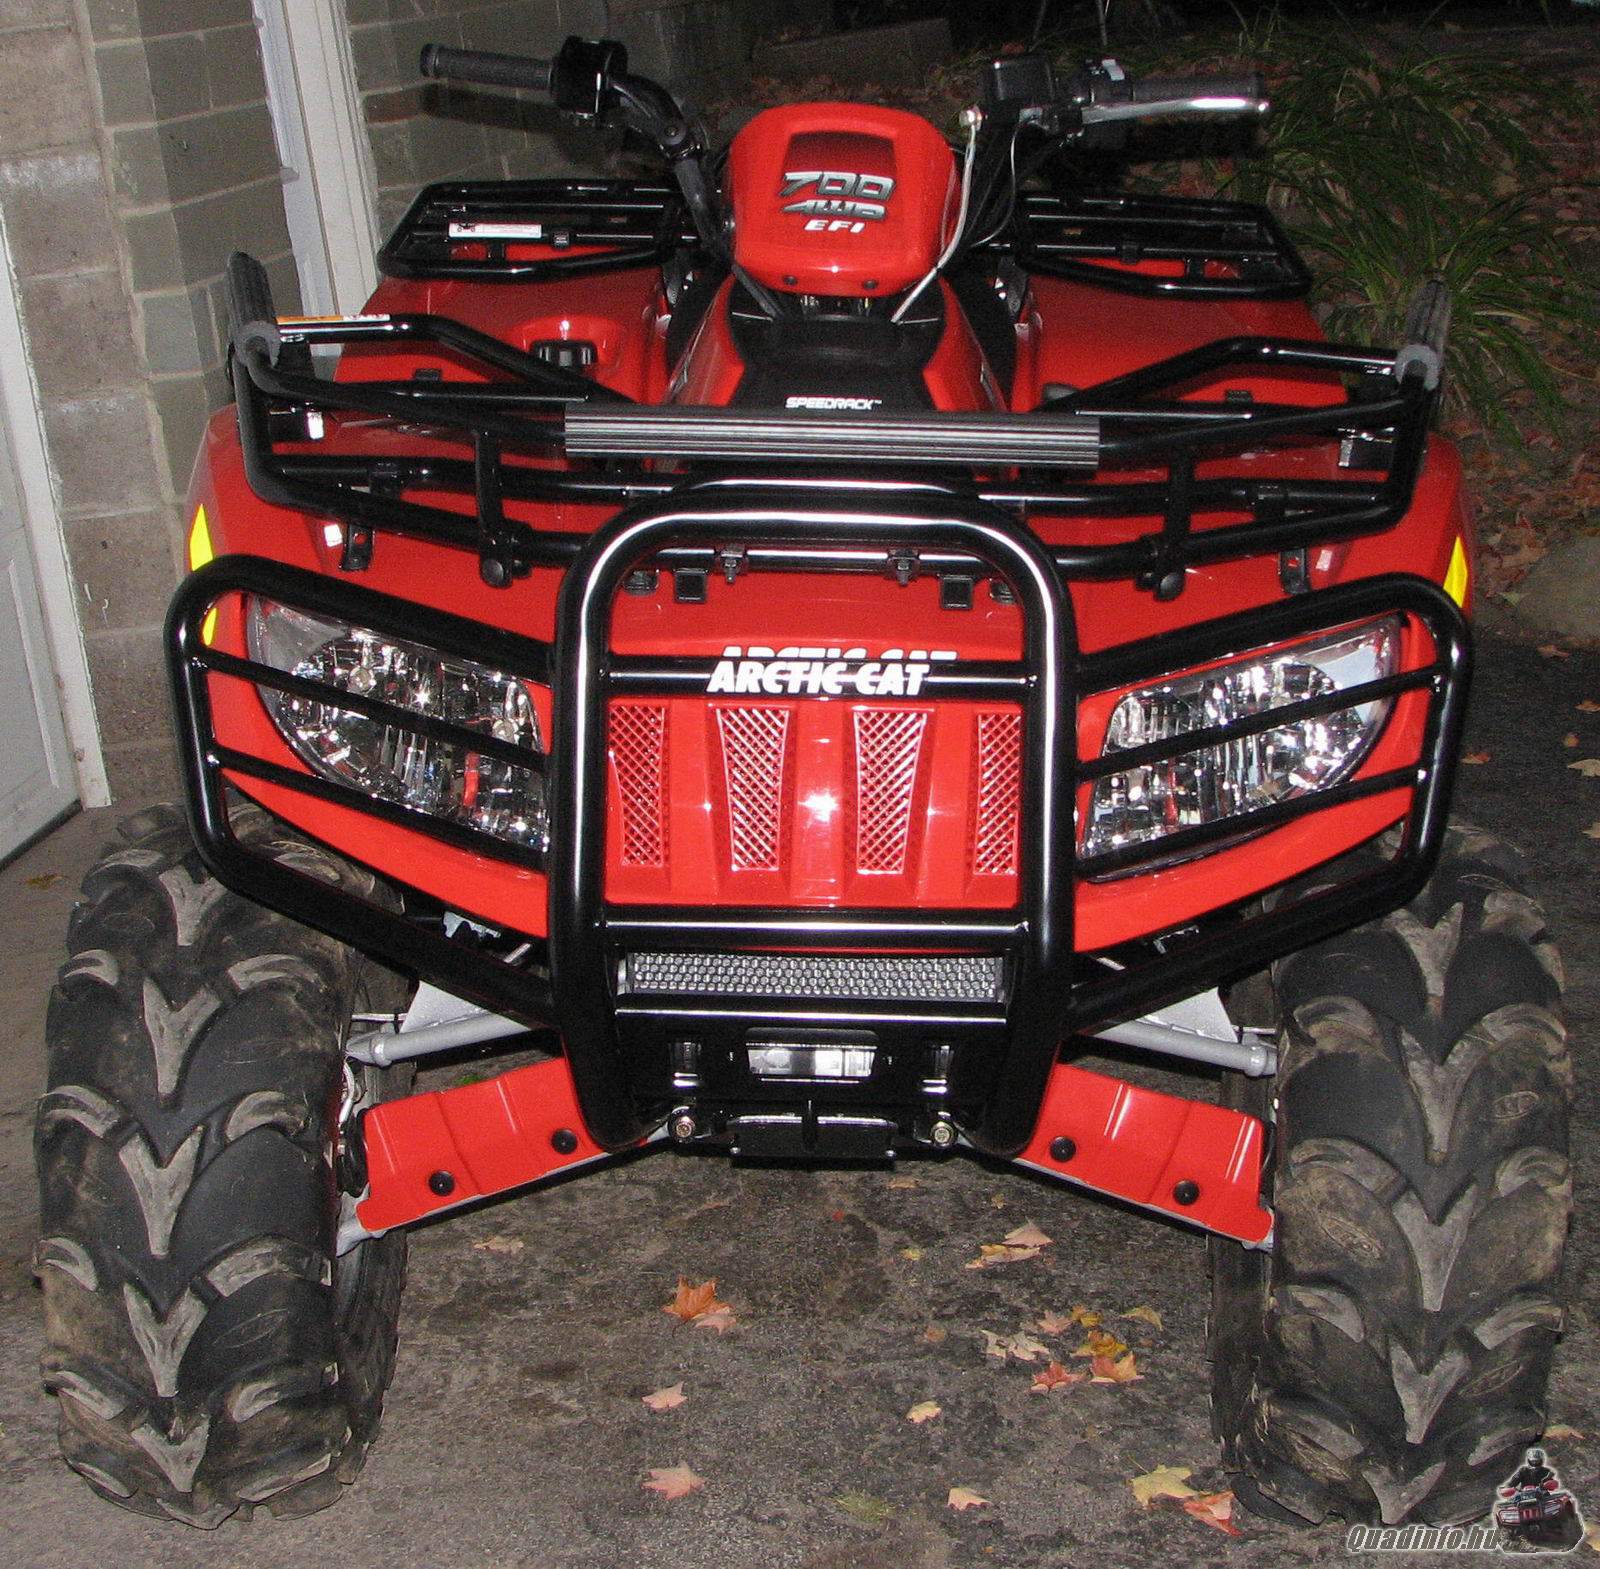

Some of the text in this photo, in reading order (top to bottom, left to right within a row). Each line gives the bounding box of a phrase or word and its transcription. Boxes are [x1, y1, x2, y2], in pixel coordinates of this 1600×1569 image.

[780, 171, 895, 200] 700
[804, 219, 865, 233] EFI
[706, 660, 930, 696] ARCTIC CAT
